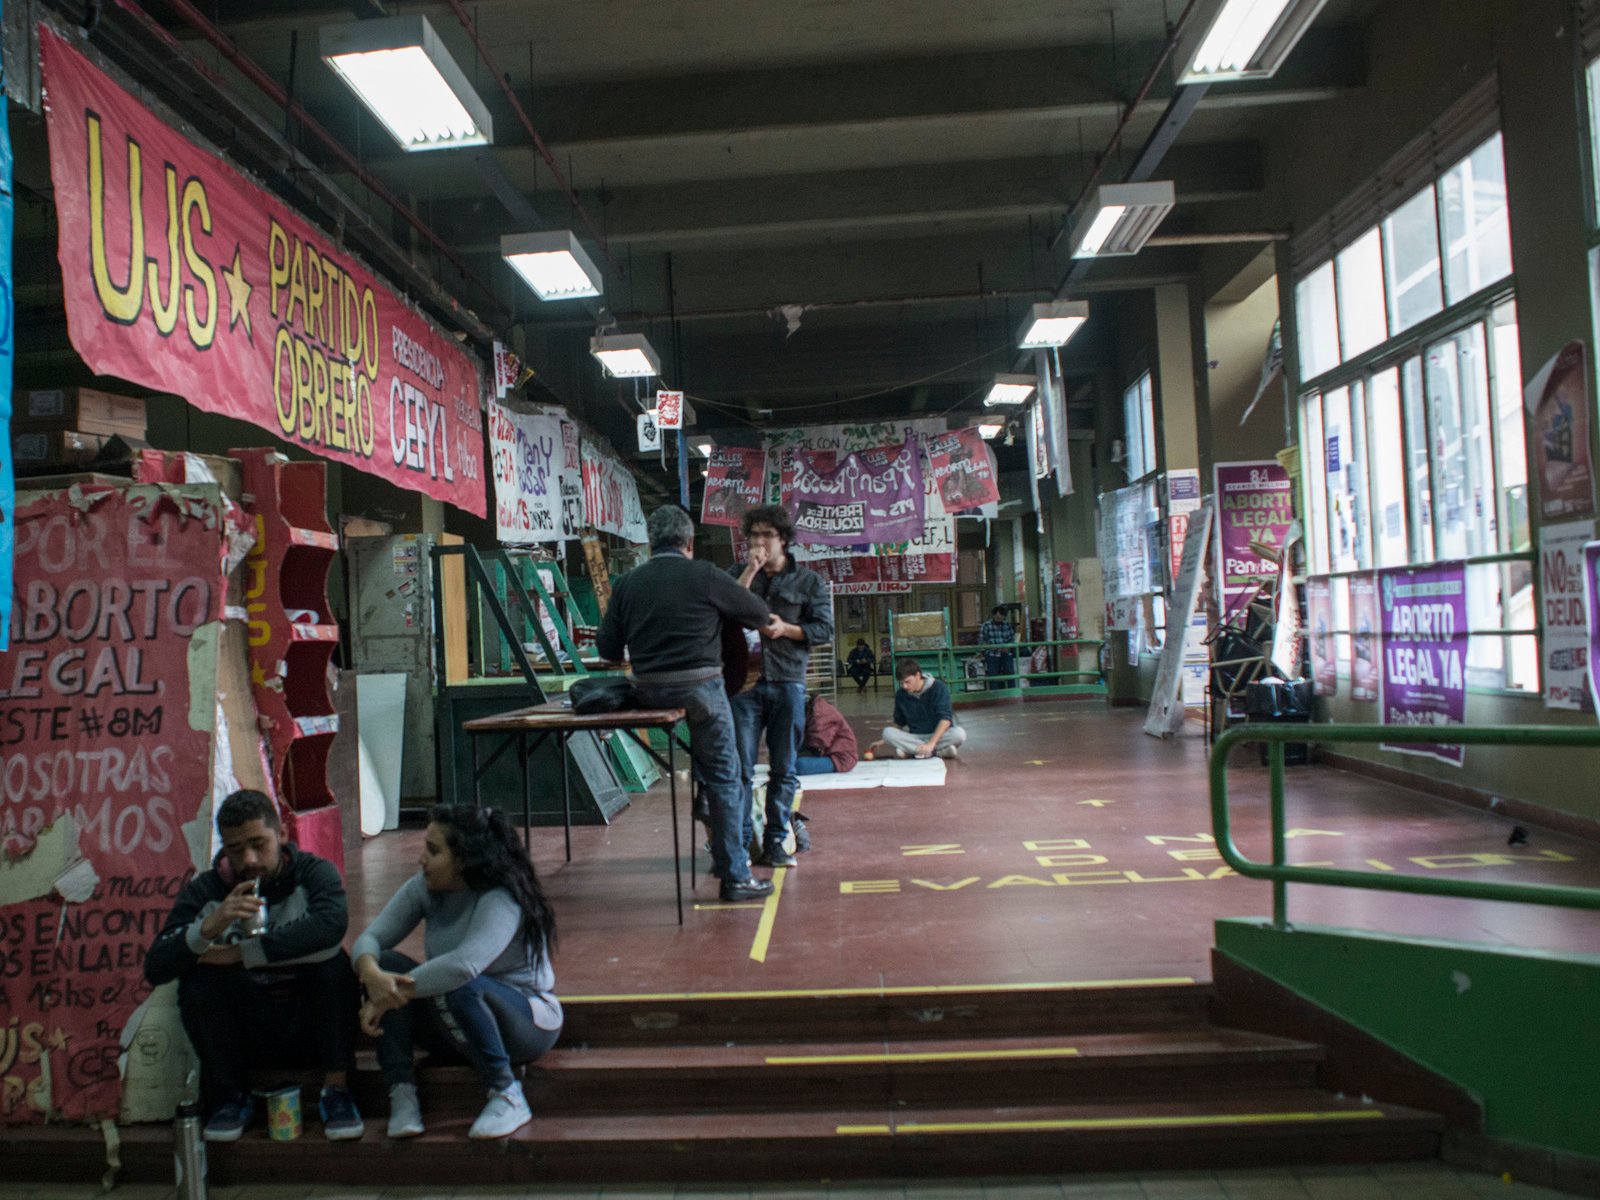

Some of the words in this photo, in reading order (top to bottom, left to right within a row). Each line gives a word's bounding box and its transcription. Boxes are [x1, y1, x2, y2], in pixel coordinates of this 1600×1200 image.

[86, 108, 218, 351] UJS
[268, 214, 380, 381] PARTIDO
[273, 323, 375, 457] OBRERO
[708, 477, 744, 488] ABORTO
[1231, 509, 1292, 527] LEGAL
[1249, 527, 1277, 543] YA
[1544, 550, 1568, 594] NO
[1390, 602, 1455, 643] ABORTO
[1546, 598, 1586, 627] DEUD
[1386, 648, 1440, 686] LEGAL
[1437, 649, 1463, 690] YA
[0, 745, 174, 798] OSOTRAS
